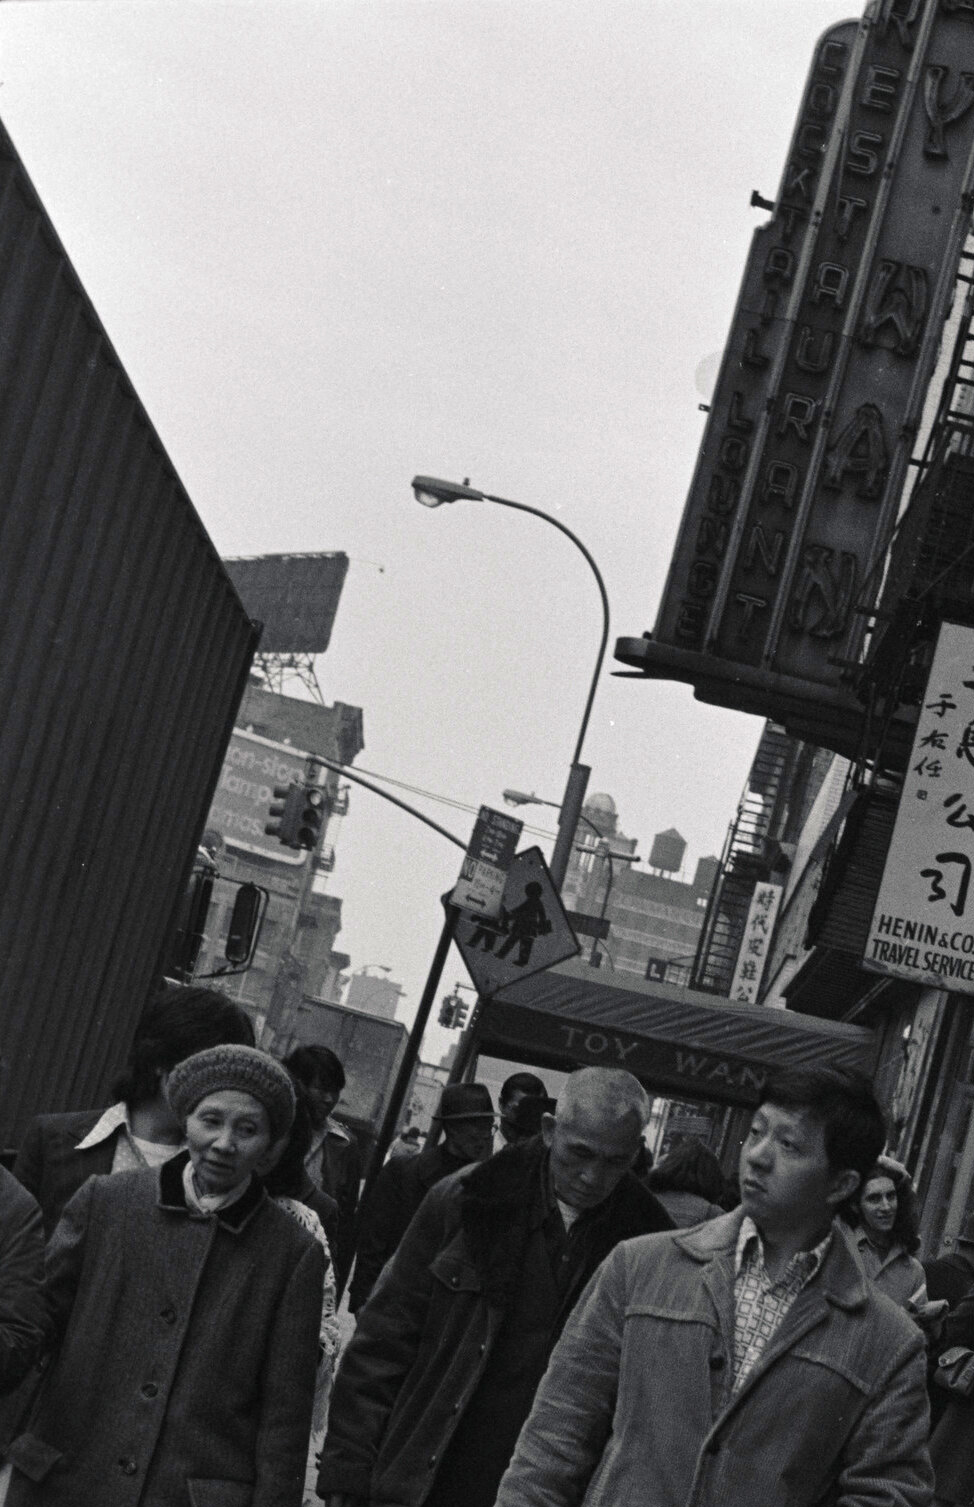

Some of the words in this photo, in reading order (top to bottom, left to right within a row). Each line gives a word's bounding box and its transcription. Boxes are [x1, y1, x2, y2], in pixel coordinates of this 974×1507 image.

[735, 0, 918, 657] RESTAURANT
[743, 40, 846, 369] COCKTAIL
[675, 392, 753, 641] LOUNGE
[560, 1024, 639, 1060] TOY
[675, 1050, 768, 1090] WAN
[872, 939, 920, 969] TRAVEL
